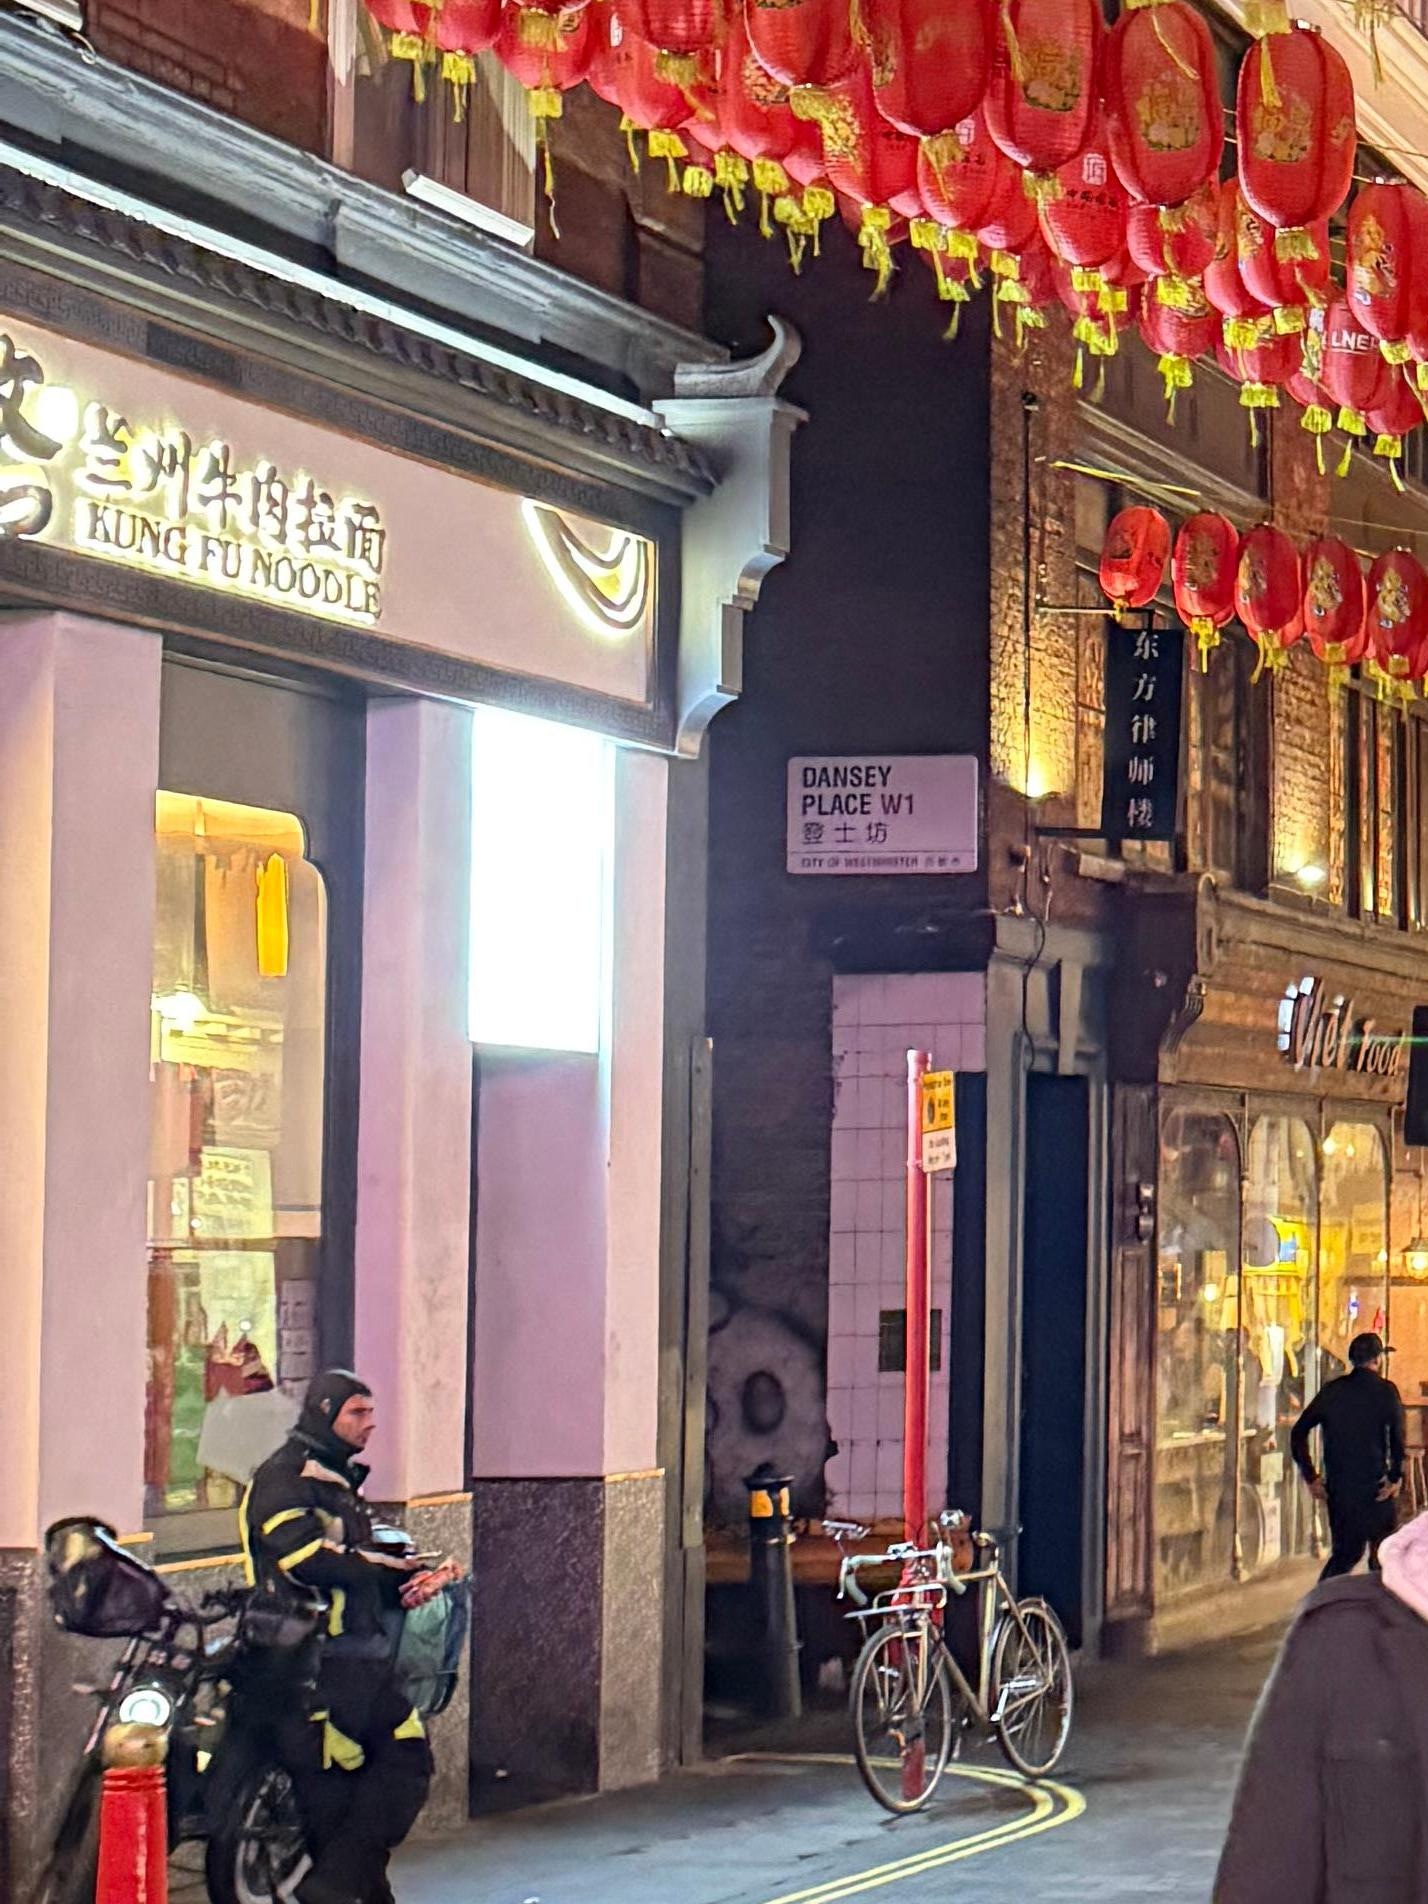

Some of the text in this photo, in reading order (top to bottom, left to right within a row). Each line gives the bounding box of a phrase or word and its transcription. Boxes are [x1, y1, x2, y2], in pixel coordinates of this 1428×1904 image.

[87, 501, 382, 619] KUNG FU NOODLE
[802, 765, 892, 788] DANSEY
[802, 793, 914, 816] PLACE W1
